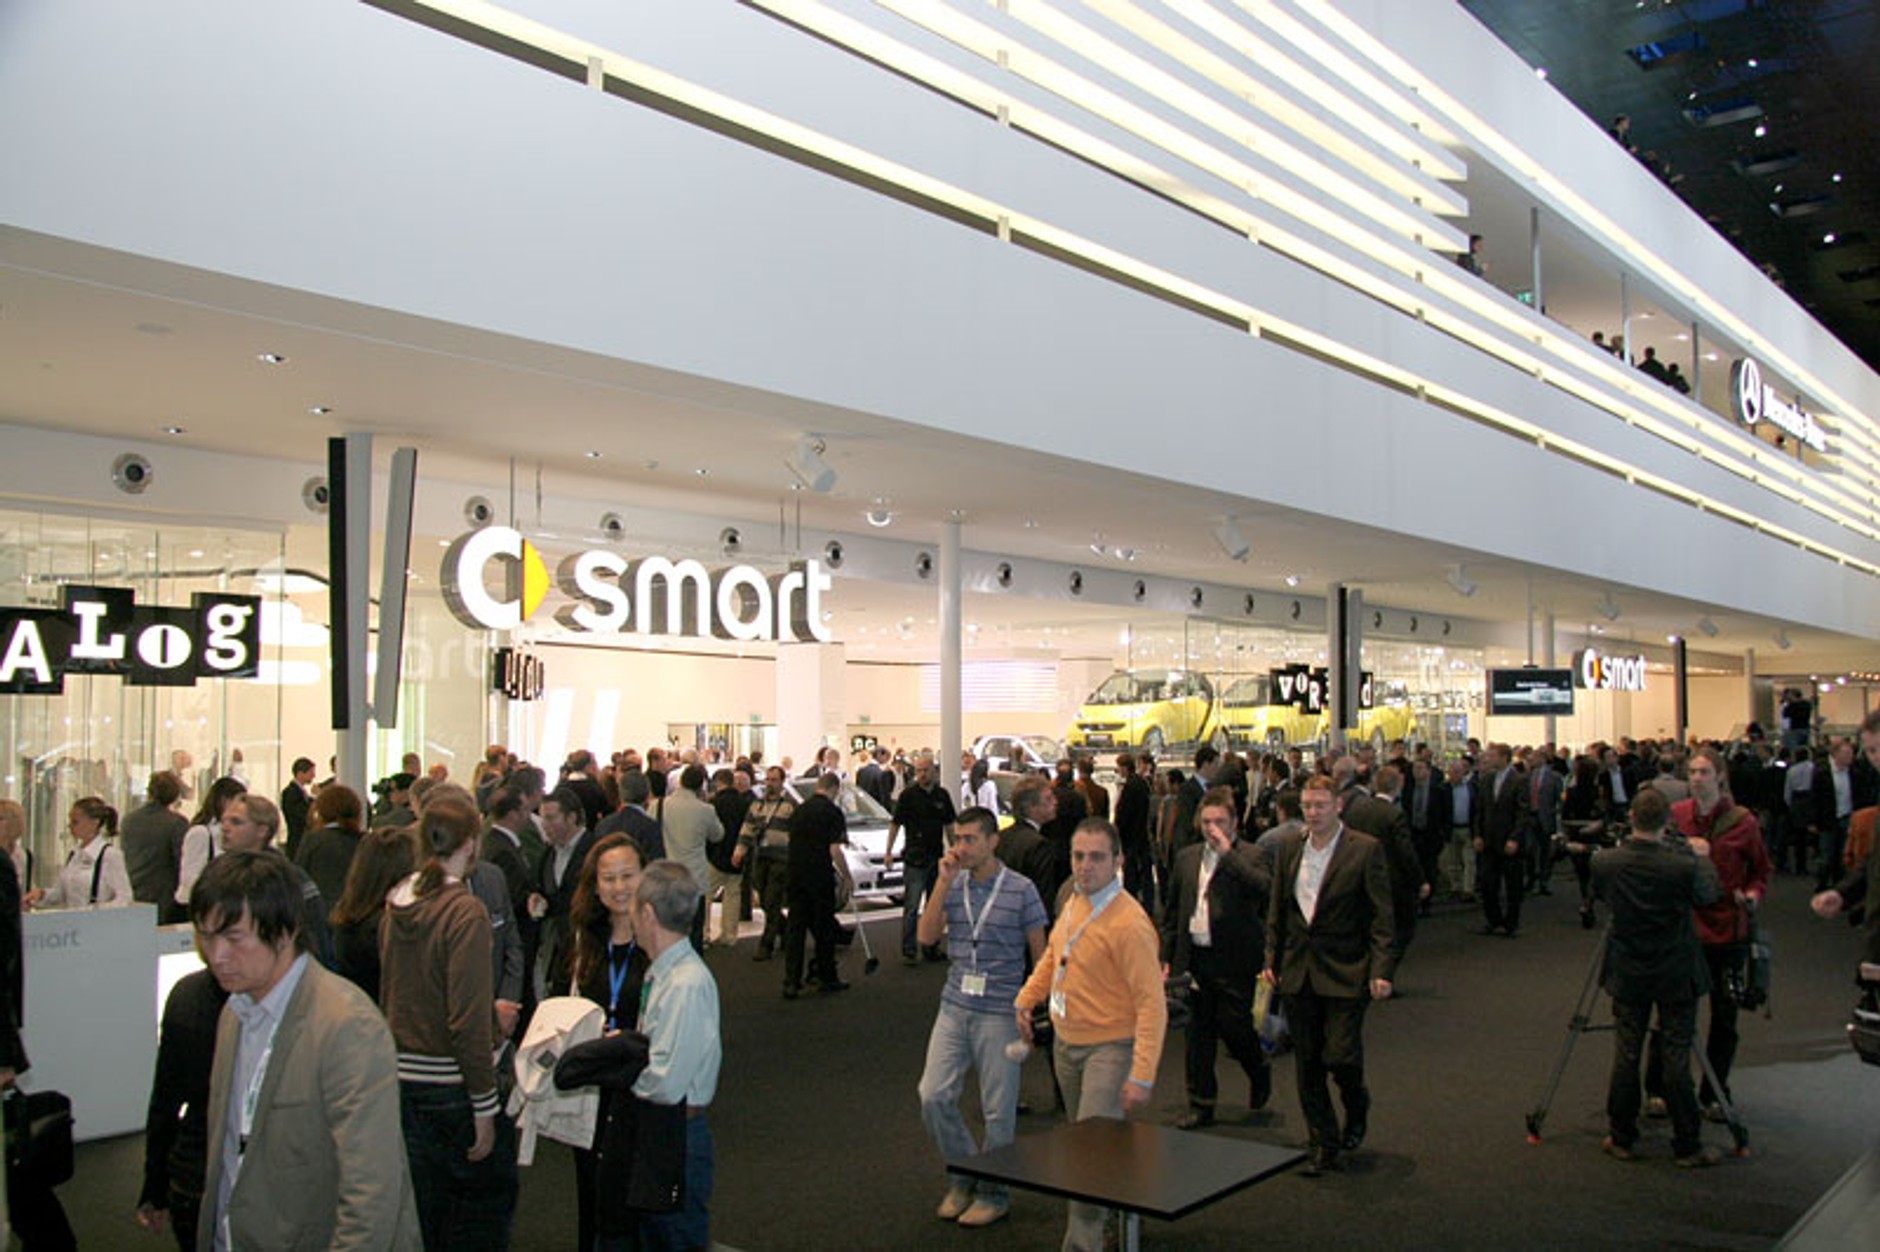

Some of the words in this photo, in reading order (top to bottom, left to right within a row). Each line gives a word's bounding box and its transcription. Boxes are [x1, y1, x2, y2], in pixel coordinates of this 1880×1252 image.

[568, 549, 832, 644] smart
[1601, 654, 1647, 692] smart
[27, 929, 81, 949] mart
